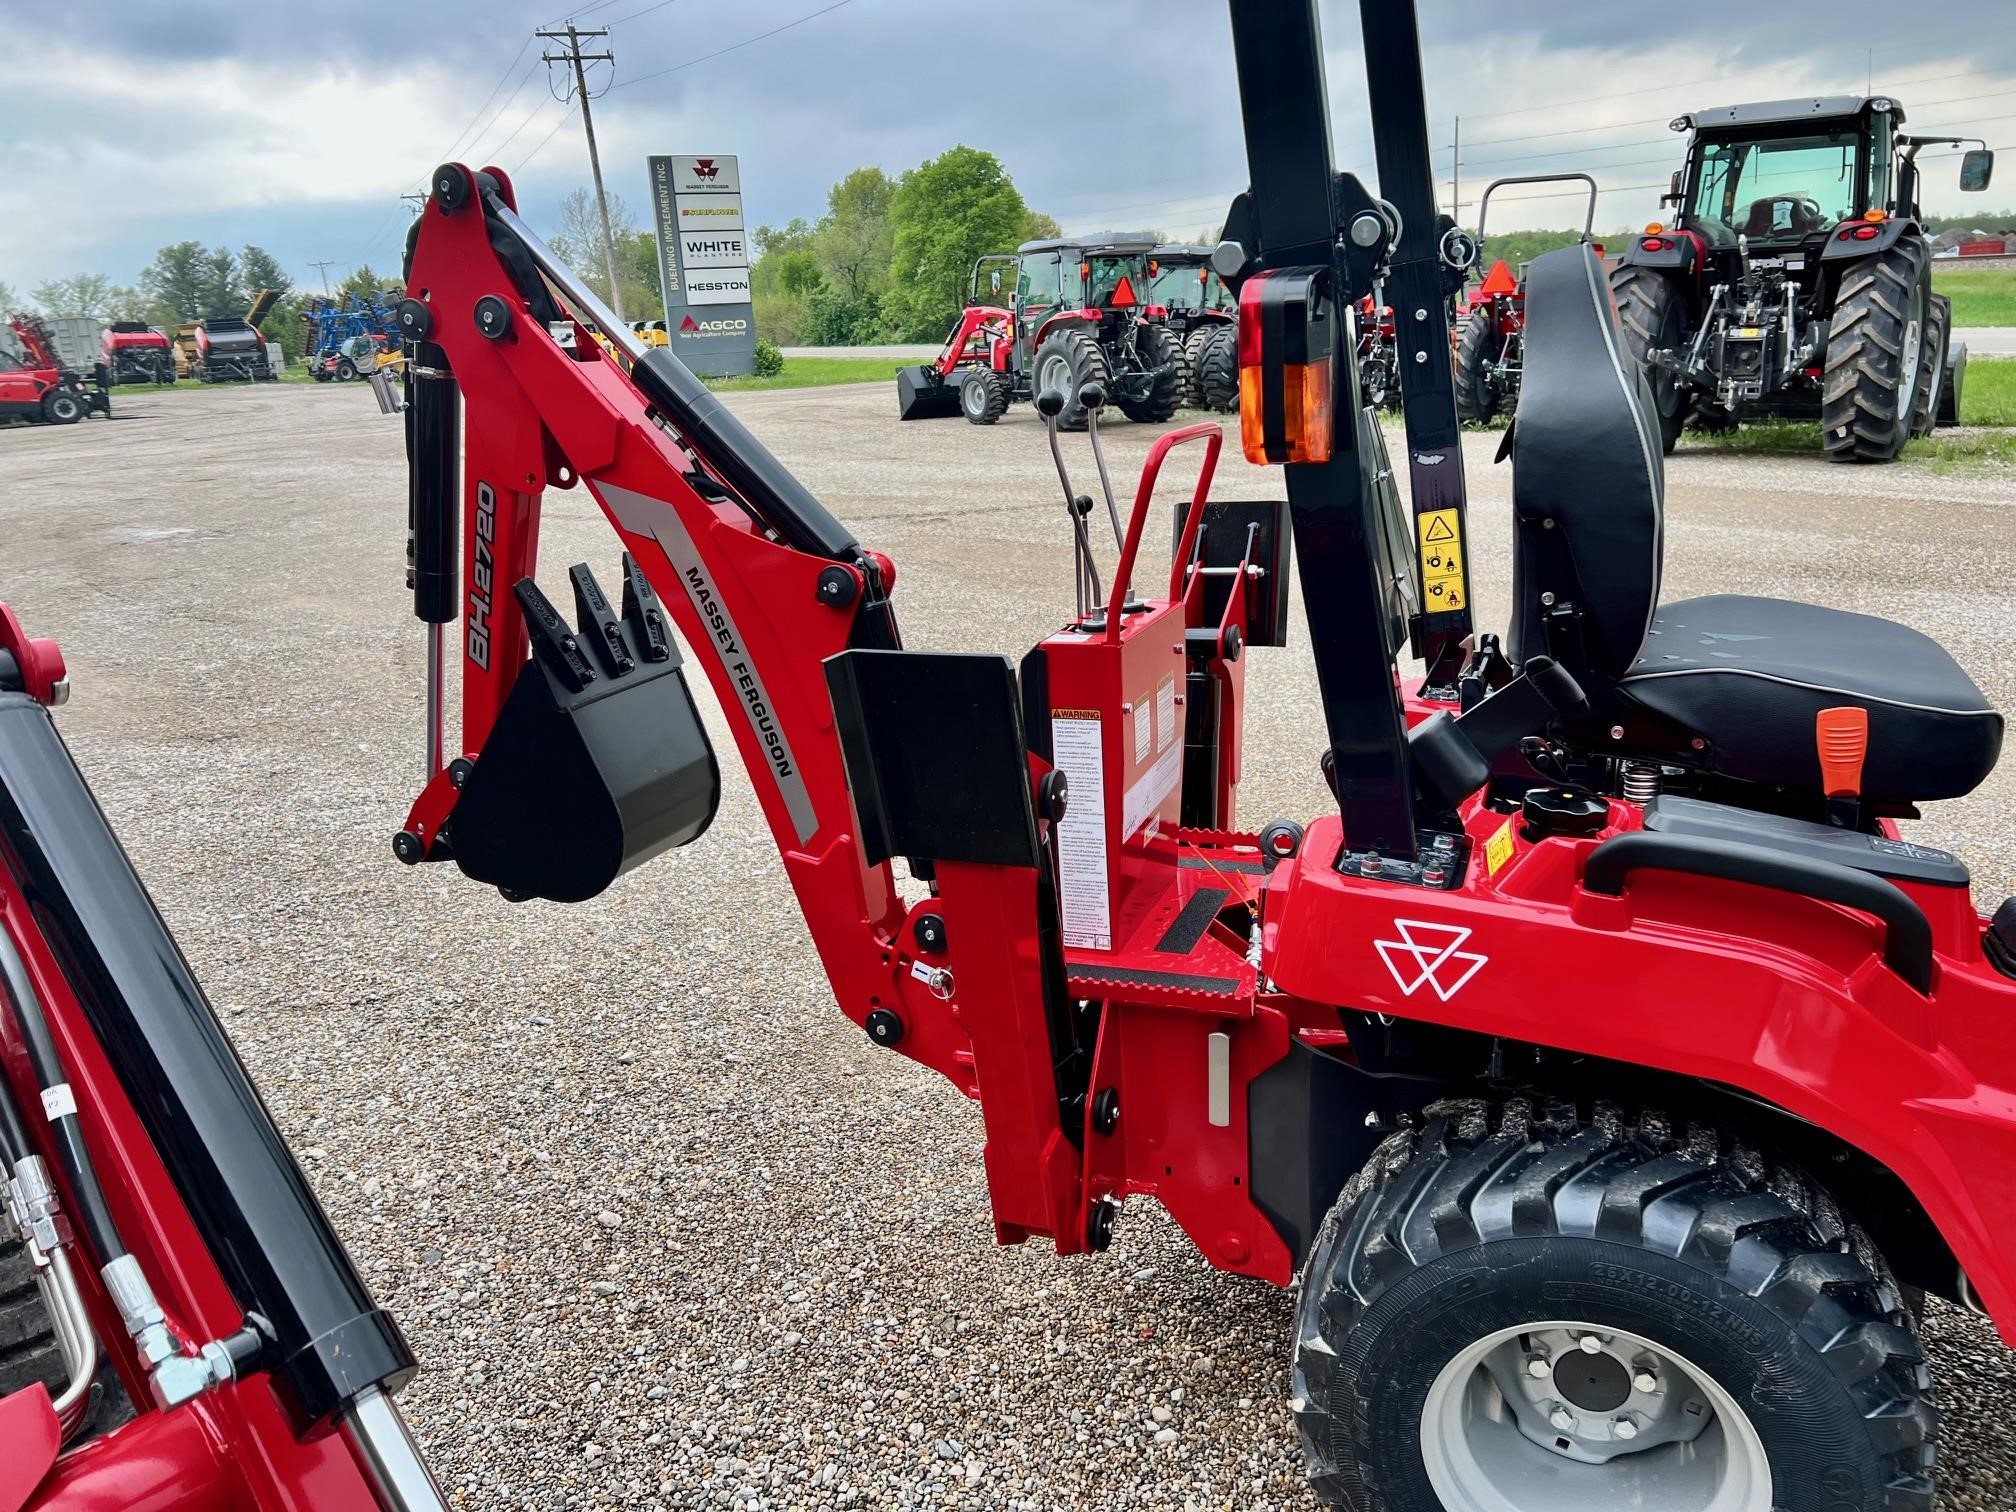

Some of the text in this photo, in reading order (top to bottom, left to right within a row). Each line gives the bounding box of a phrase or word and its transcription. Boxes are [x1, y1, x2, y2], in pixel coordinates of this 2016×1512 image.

[657, 162, 679, 291] BUENING IMPLEMENT INC.
[687, 241, 742, 252] WHITE
[688, 281, 748, 291] HESSTON
[699, 319, 747, 331] AGCO
[693, 331, 721, 339] Agriculture
[469, 481, 496, 672] BH.2720
[686, 566, 793, 778] MASSEY FERGUSON
[1061, 710, 1099, 719] WARNING
